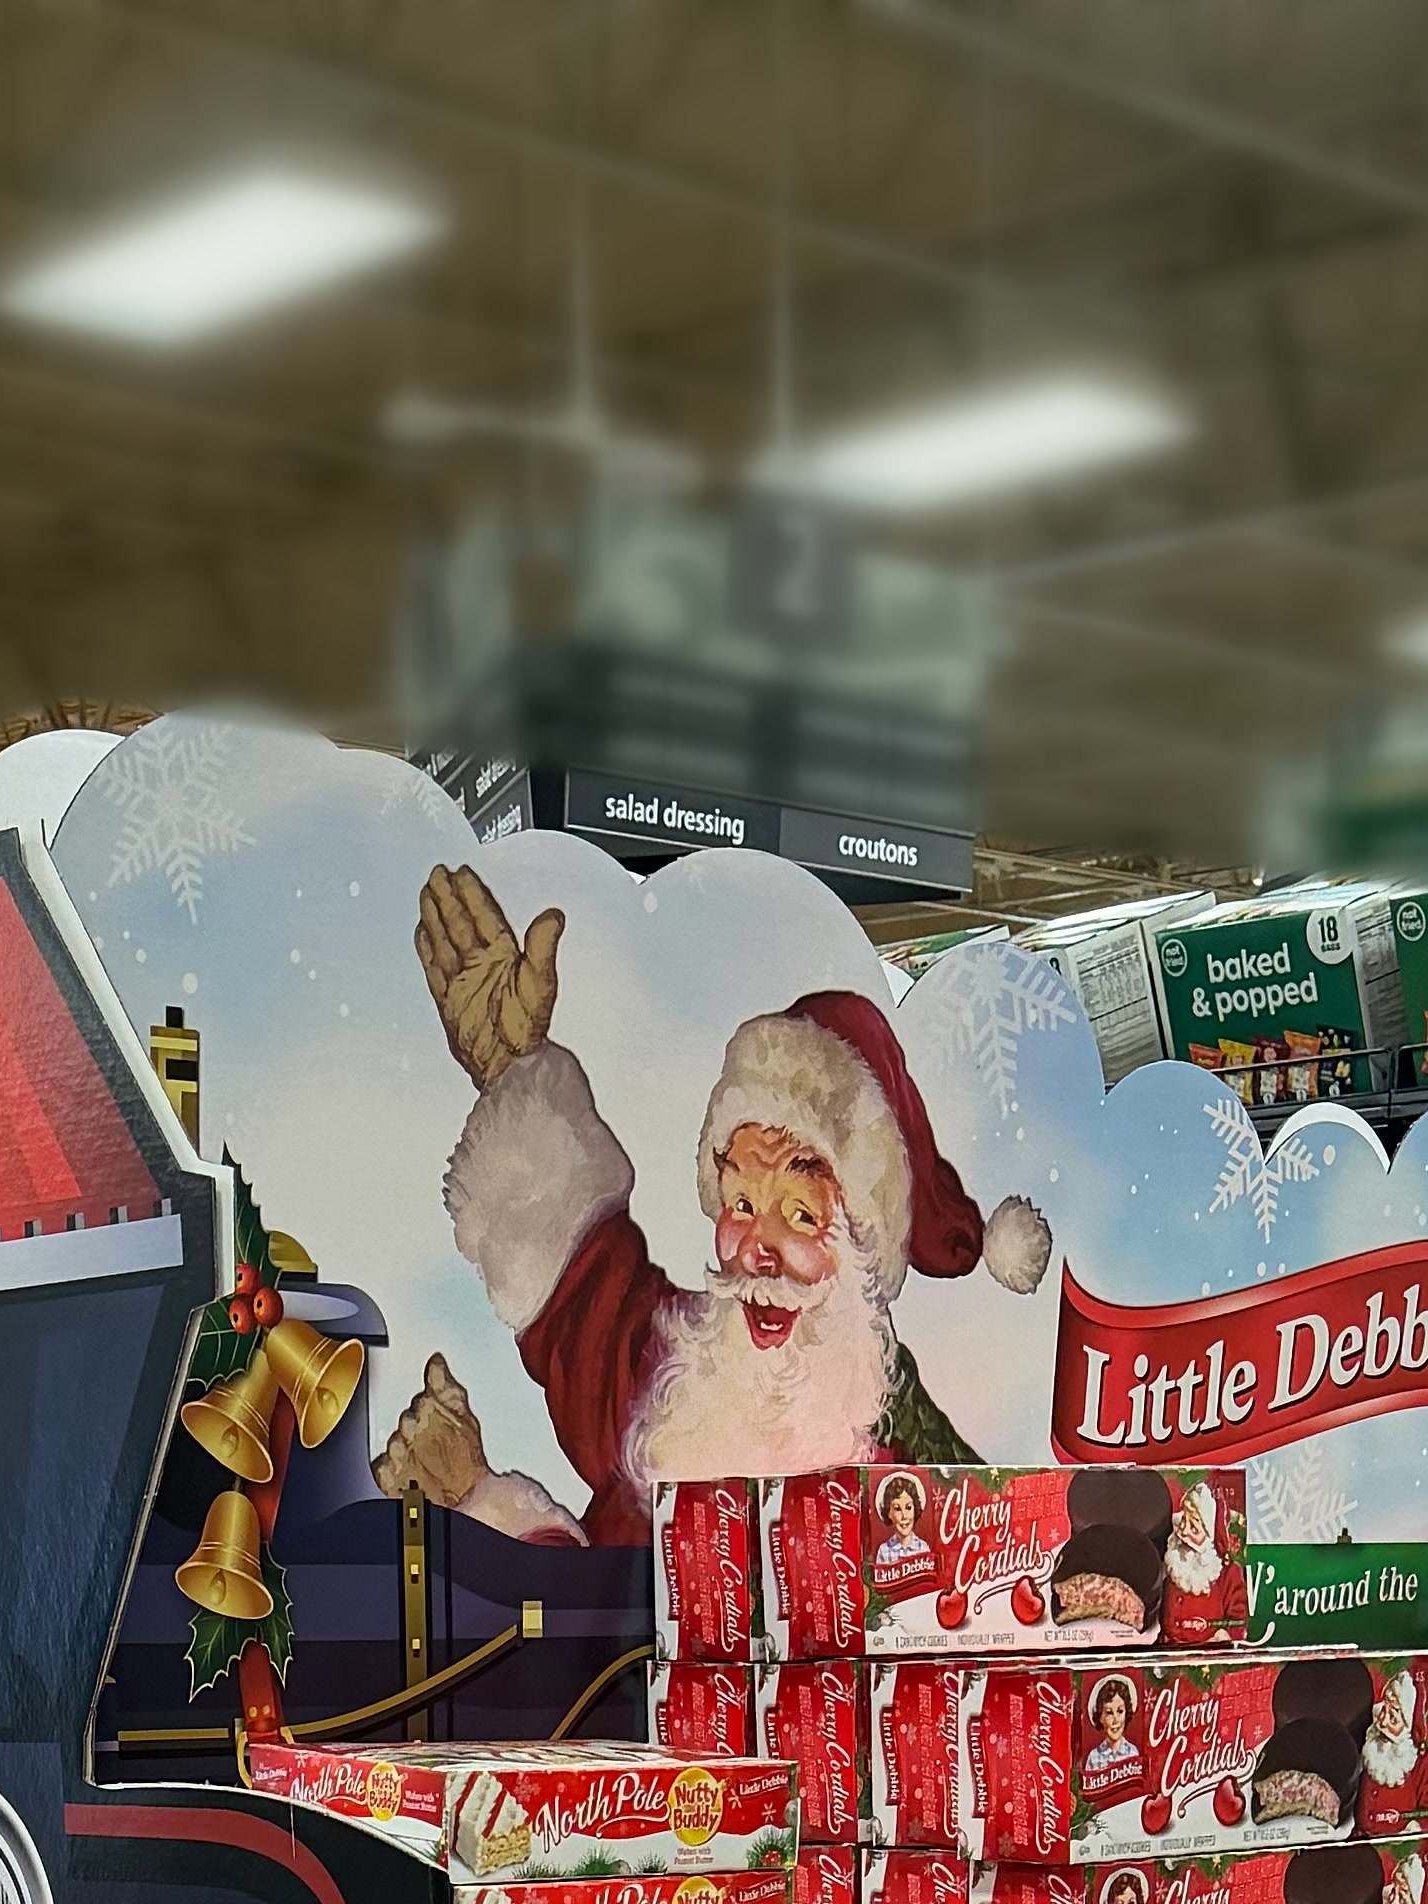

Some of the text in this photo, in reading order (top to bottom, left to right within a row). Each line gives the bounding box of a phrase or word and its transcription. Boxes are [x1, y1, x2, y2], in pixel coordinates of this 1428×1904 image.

[606, 794, 744, 844] salad dressing
[838, 832, 918, 867] croutons
[1318, 915, 1339, 943] 18
[1207, 942, 1291, 984] baked
[1192, 971, 1319, 1022] & popped
[1076, 1341, 1256, 1449] Little
[940, 1479, 1012, 1545] Cherry
[874, 1558, 935, 1583] Little Debbie
[954, 1520, 1057, 1593] Cordials
[1274, 1571, 1371, 1617] around
[1378, 1566, 1418, 1602] the
[1149, 1677, 1221, 1751] Cherry
[1083, 1760, 1144, 1791] Little Debbie
[1162, 1719, 1258, 1800] Cordials
[535, 1772, 670, 1854] North Pole
[673, 1805, 720, 1831] Buddy
[674, 1782, 720, 1807] Nutty
